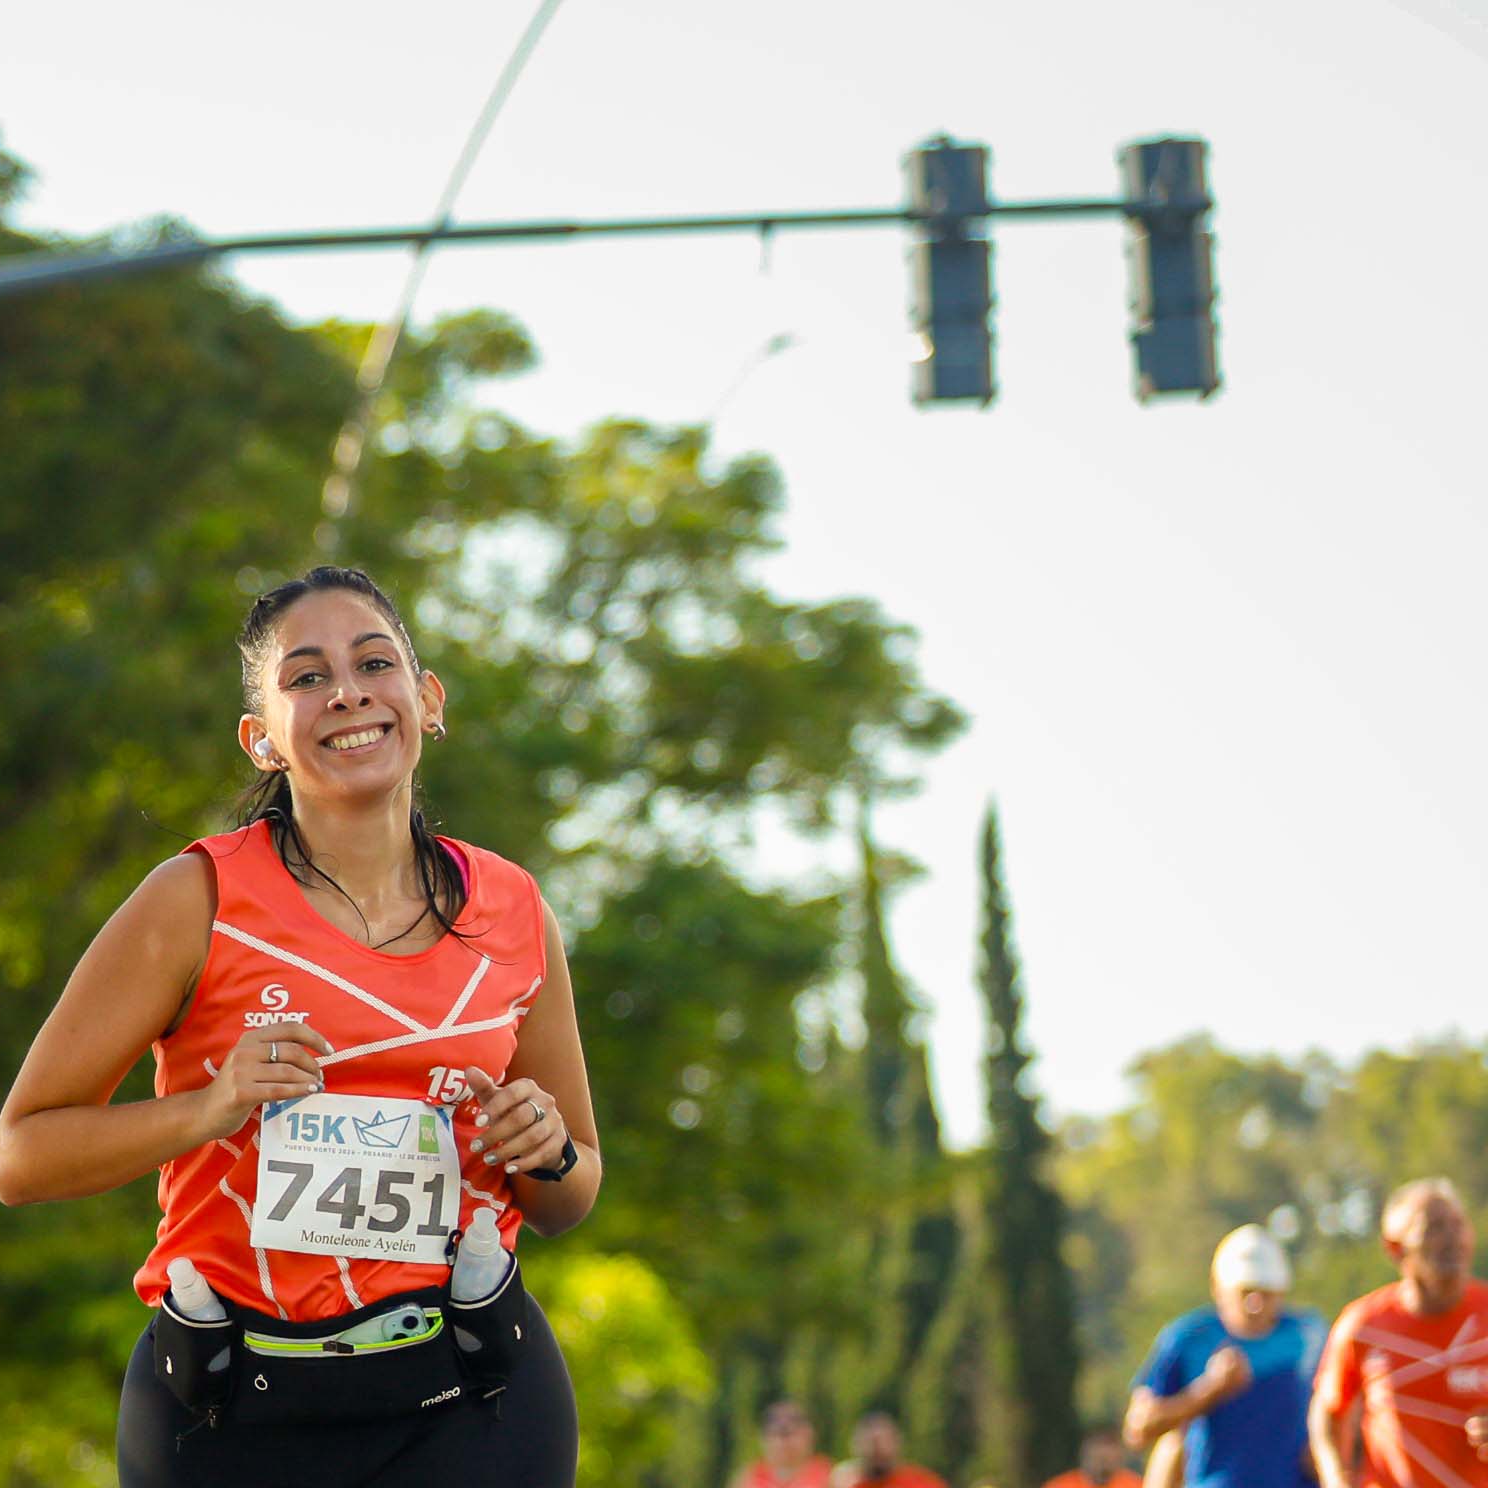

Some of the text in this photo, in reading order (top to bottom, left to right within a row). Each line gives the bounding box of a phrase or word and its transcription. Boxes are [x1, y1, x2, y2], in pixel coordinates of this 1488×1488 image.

[286, 1112, 348, 1145] 15K
[266, 1159, 450, 1237] 7451
[300, 1229, 416, 1253] Monteleone Ayelén
